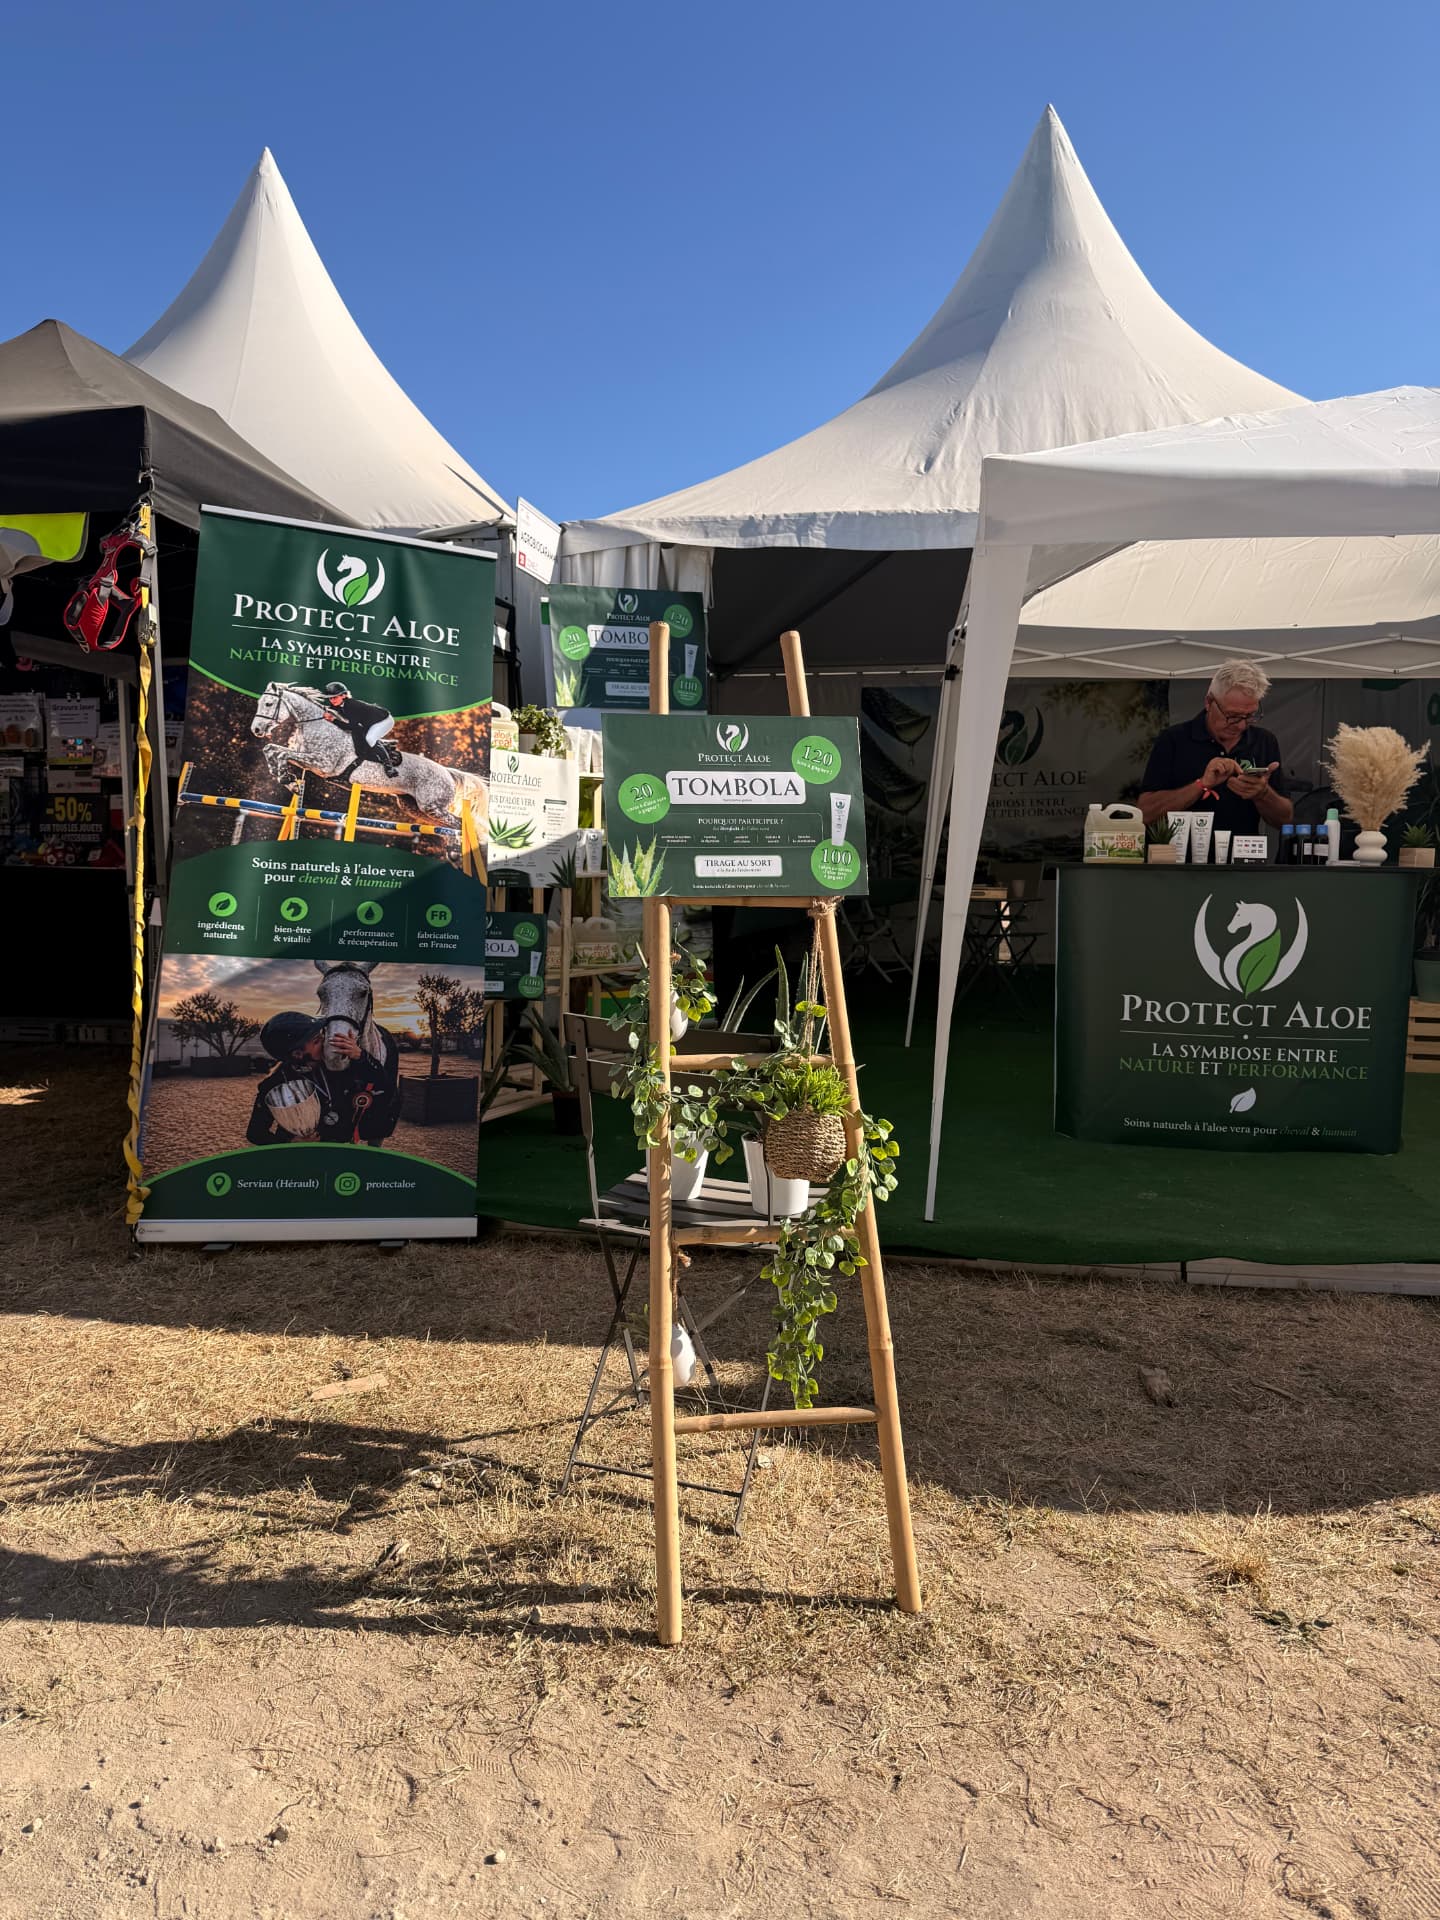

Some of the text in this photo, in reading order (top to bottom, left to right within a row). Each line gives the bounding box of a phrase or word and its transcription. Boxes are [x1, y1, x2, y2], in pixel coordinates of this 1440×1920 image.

[232, 593, 460, 647] PROTECT ALOE
[591, 629, 649, 645] TOMBO
[261, 636, 431, 668] LA SYMBIOSE ENTRE
[229, 648, 459, 687] NATURE ET PERFORMANCE
[698, 753, 771, 763] PROTECT ALOE
[802, 745, 833, 767] 120
[491, 772, 522, 785] ROTECT
[1033, 769, 1088, 786] ALOE
[630, 783, 653, 802] 20
[671, 777, 801, 796] TOMBOLA
[45, 796, 93, 823] -50%
[987, 799, 1025, 808] MBIOSE
[704, 859, 773, 867] TIRAGE AU SORT
[820, 847, 852, 866] 100
[252, 857, 415, 878] Soins naturels à l'aloe vera
[264, 872, 403, 889] pour cheval & humain
[430, 911, 448, 921] FR
[197, 919, 245, 932] ingrédients
[273, 924, 312, 935] bien-être
[203, 930, 238, 940] naturels
[273, 933, 312, 944] & vitalité
[342, 929, 395, 940] performance
[417, 931, 459, 941] fabrication
[338, 937, 398, 949] & récupération
[430, 940, 457, 950] France
[485, 942, 516, 953] BOLA
[1120, 994, 1372, 1031] PROTECT ALOE
[1152, 1043, 1338, 1063] LA SYMBIOSE ENTRE
[1119, 1057, 1369, 1081] NATURE ET PERFORMANCE
[1123, 1117, 1151, 1128] Soins
[1153, 1119, 1192, 1132] naturels
[1194, 1122, 1201, 1132] à
[1202, 1122, 1228, 1134] l'aloe
[1230, 1125, 1251, 1134] vera
[1253, 1126, 1278, 1138] pour
[1279, 1125, 1310, 1136] cheval
[1311, 1126, 1320, 1137] &
[237, 1177, 320, 1191] Servian (Hérault)
[366, 1178, 416, 1192] protectaloe
